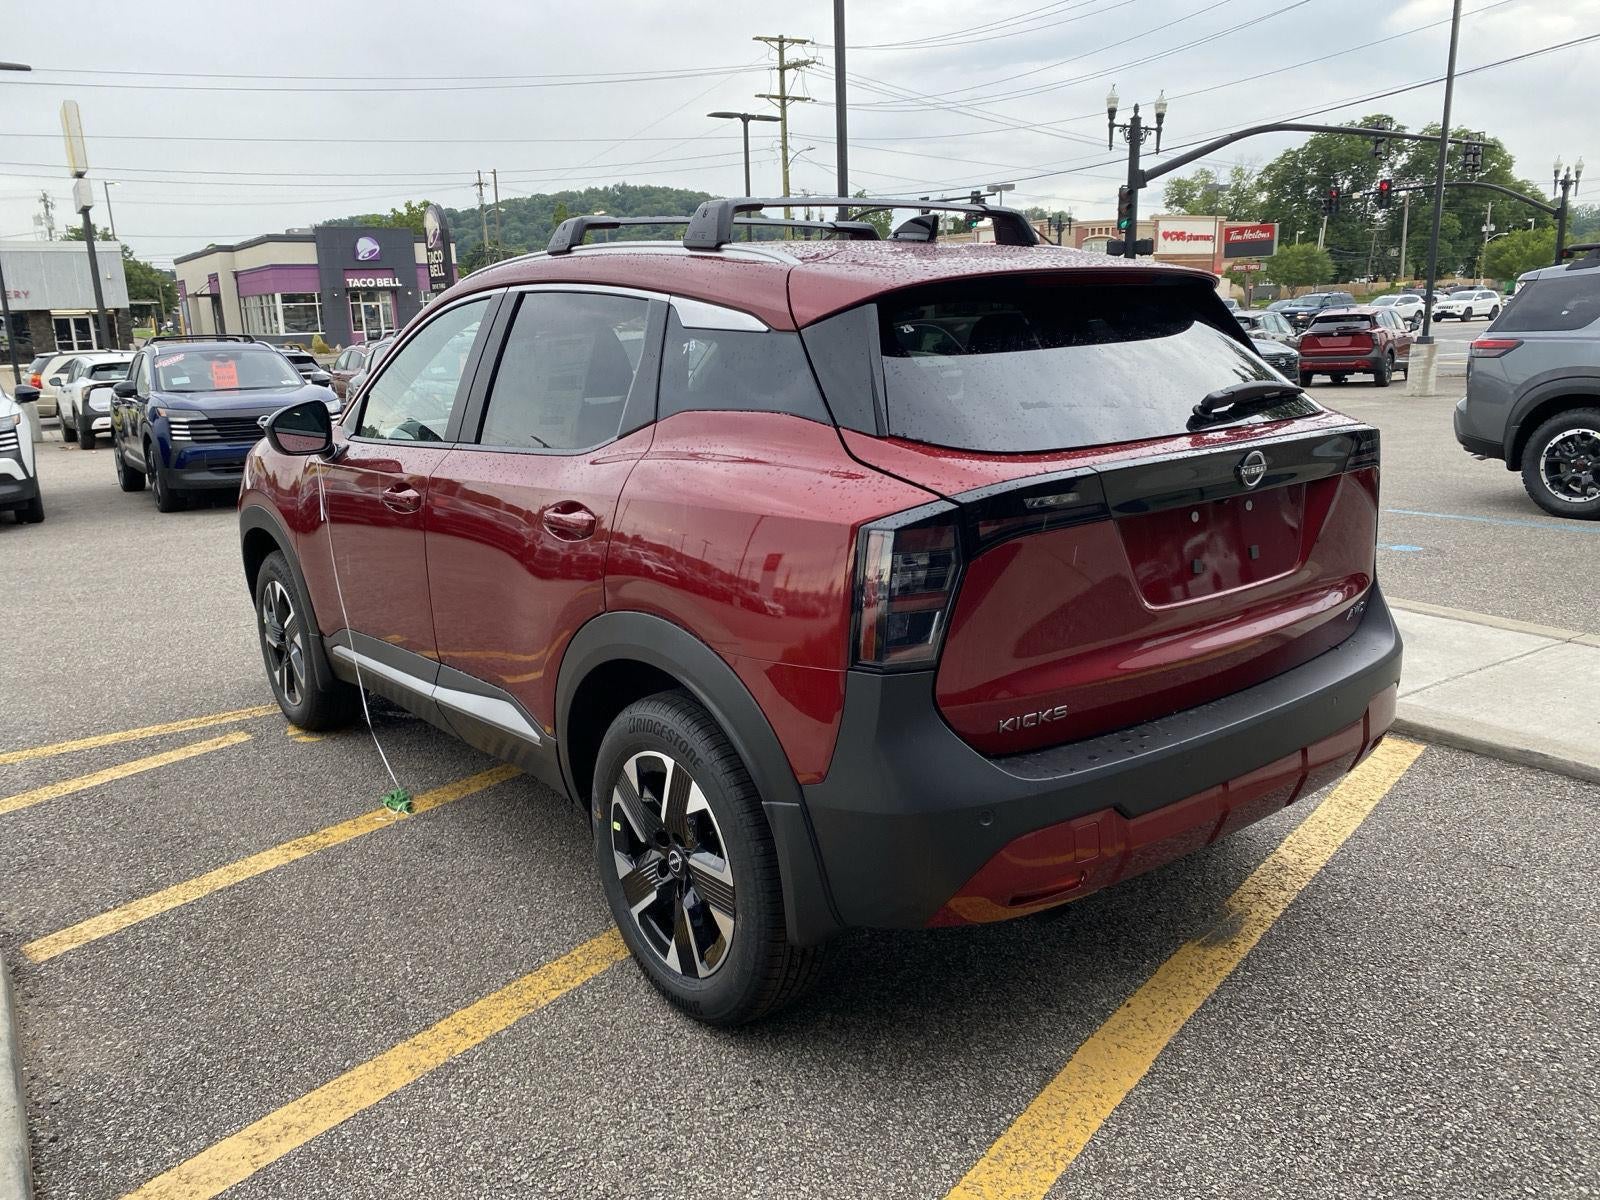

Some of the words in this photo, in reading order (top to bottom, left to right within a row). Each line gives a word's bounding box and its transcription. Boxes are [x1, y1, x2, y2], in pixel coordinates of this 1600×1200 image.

[1170, 231, 1186, 242] CVS
[1229, 230, 1243, 242] Tim
[1243, 229, 1270, 241] Hortons
[427, 250, 443, 264] TACO
[429, 263, 446, 278] BELL
[346, 278, 376, 288] TACO
[376, 277, 402, 287] BELL
[1241, 465, 1267, 476] NISSAN
[998, 704, 1068, 734] KICKS
[627, 716, 705, 772] BRIDGESTONE
